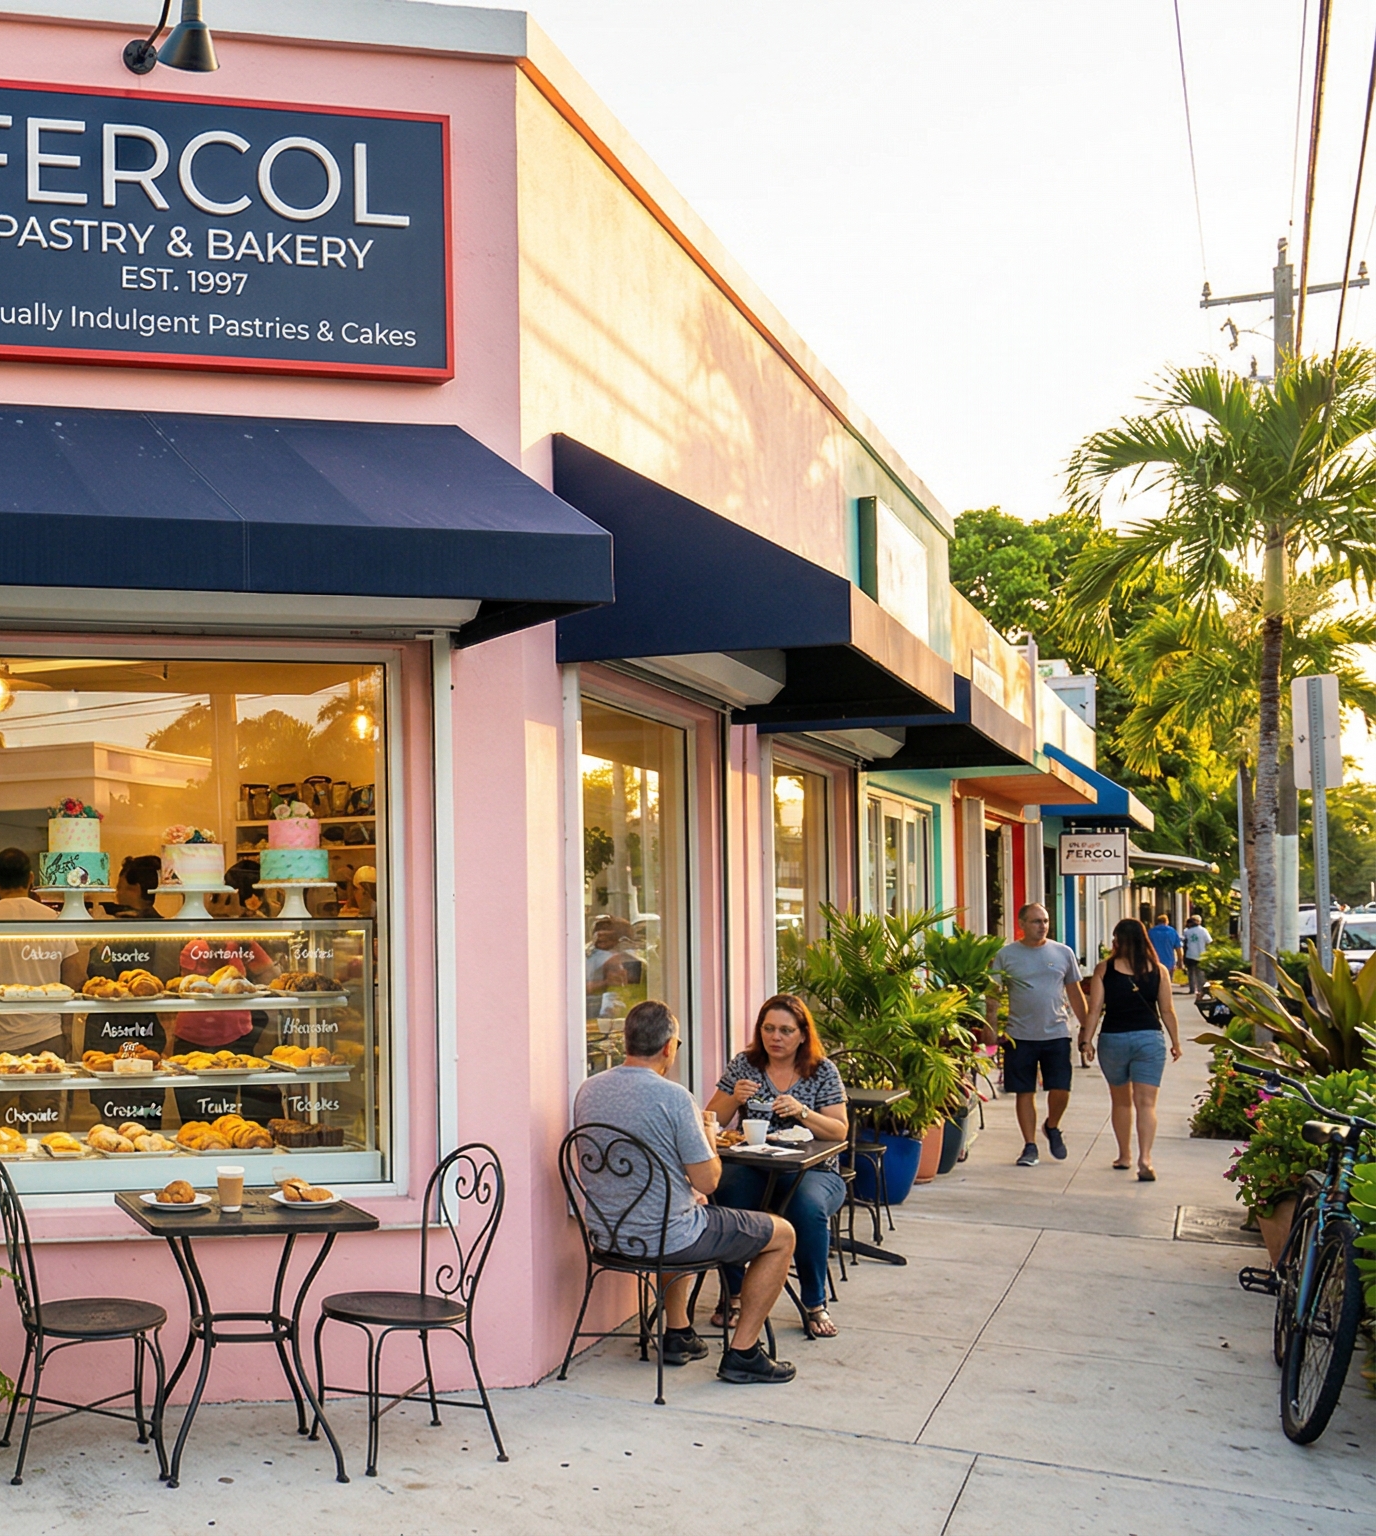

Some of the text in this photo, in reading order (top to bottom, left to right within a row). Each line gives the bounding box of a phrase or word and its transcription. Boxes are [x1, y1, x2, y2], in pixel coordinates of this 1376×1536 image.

[166, 229, 194, 260] &
[207, 229, 375, 270] BAKERY
[120, 265, 249, 297] EST. 1997
[70, 306, 201, 338] Indulgent
[207, 312, 311, 342] Pastries
[316, 319, 335, 344] &
[341, 321, 417, 349] Cakes
